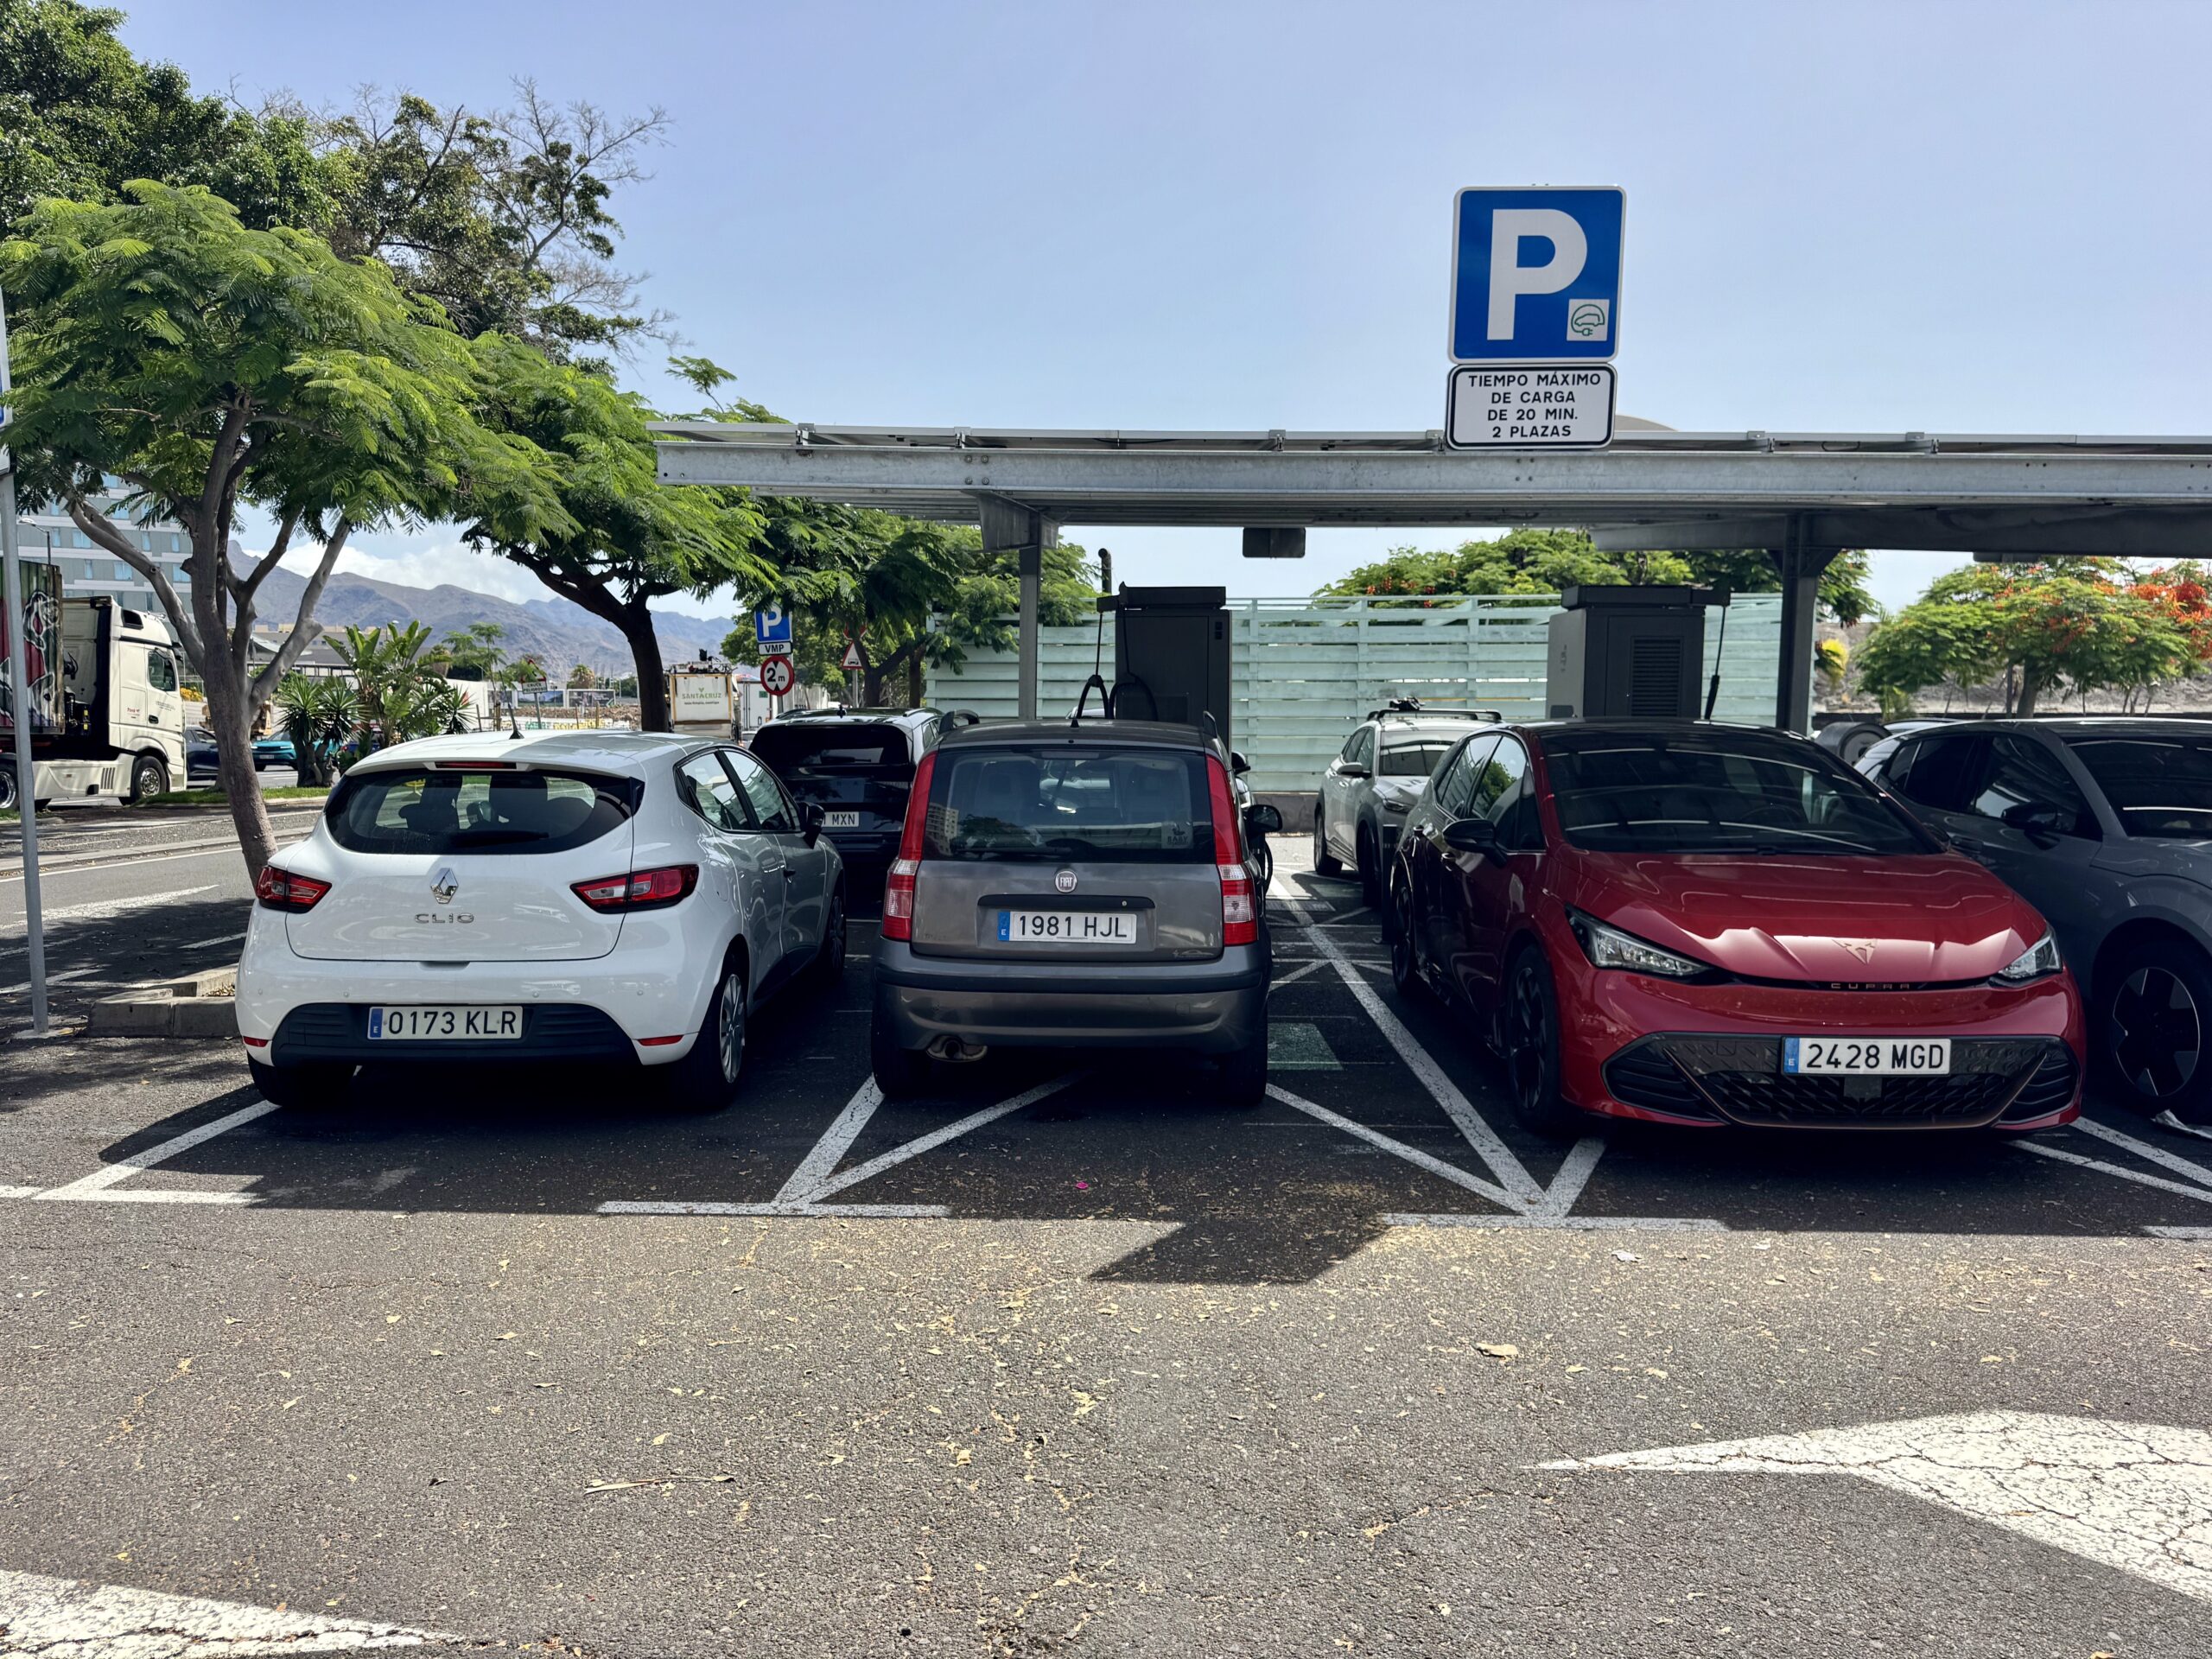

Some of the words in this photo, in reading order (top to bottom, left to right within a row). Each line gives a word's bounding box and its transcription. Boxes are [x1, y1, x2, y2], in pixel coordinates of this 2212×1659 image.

[1486, 208, 1588, 341] P
[1468, 374, 1529, 387] TIEMPO
[1536, 371, 1601, 386] MÁXIMO
[1491, 391, 1512, 404] DE
[1520, 391, 1576, 404] CARGA
[1487, 409, 1508, 421] DE
[1516, 408, 1536, 421] 20
[1545, 408, 1578, 420] MIN.
[1492, 426, 1502, 438] 2
[1510, 425, 1572, 438] PLAZAS
[761, 603, 783, 638] P
[764, 644, 785, 654] VMP
[766, 667, 777, 683] 2
[831, 814, 855, 825] MXN
[1059, 877, 1073, 887] FIAT
[415, 912, 474, 924] CLIO
[1019, 915, 1073, 937] 1981
[1084, 916, 1128, 938] HJL
[388, 1010, 455, 1035] 0173
[466, 1010, 517, 1035] KLR
[1788, 1058, 1795, 1066] E
[1806, 1043, 1880, 1069] 2428
[1891, 1044, 1944, 1069] MGD
